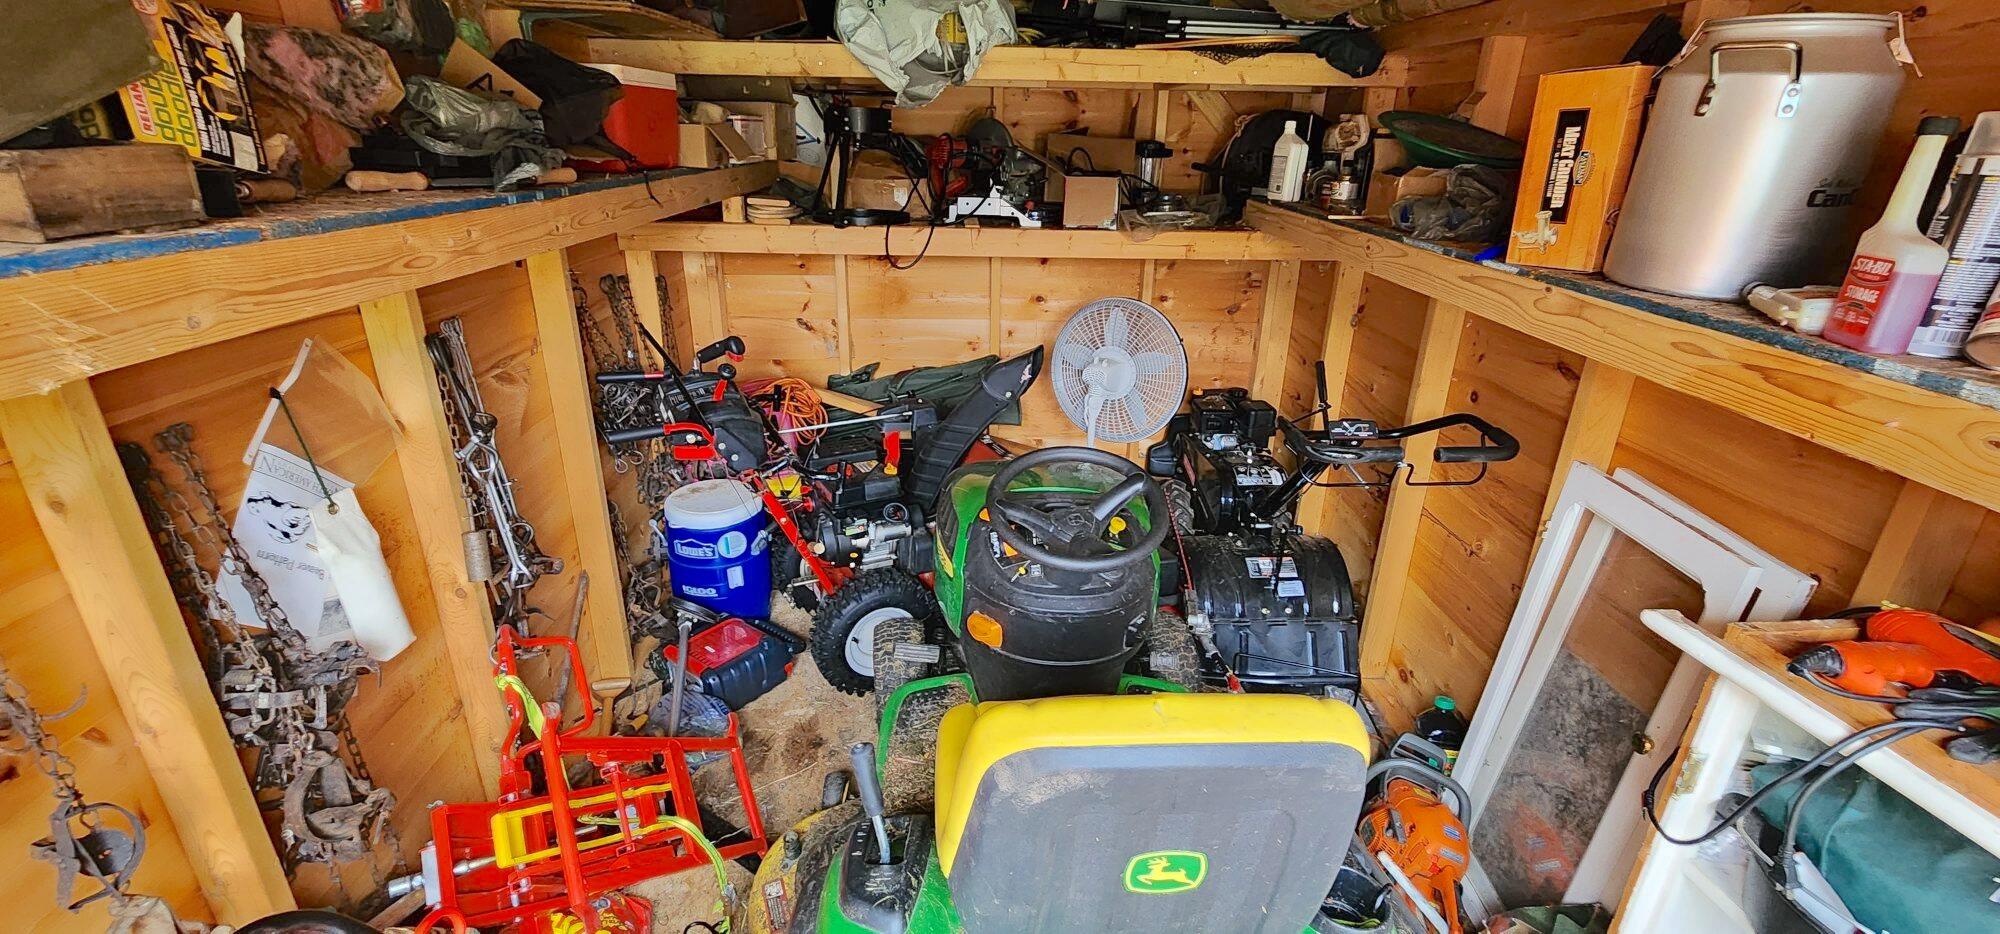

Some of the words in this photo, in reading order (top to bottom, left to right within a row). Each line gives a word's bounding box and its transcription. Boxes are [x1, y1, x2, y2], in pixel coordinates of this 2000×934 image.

[129, 83, 154, 132] RELIAN
[145, 76, 177, 141] doub
[1560, 126, 1582, 158] MEAT
[1550, 159, 1574, 208] GRINDER
[1844, 284, 1880, 304] STORAGE
[256, 550, 294, 572] Pattern
